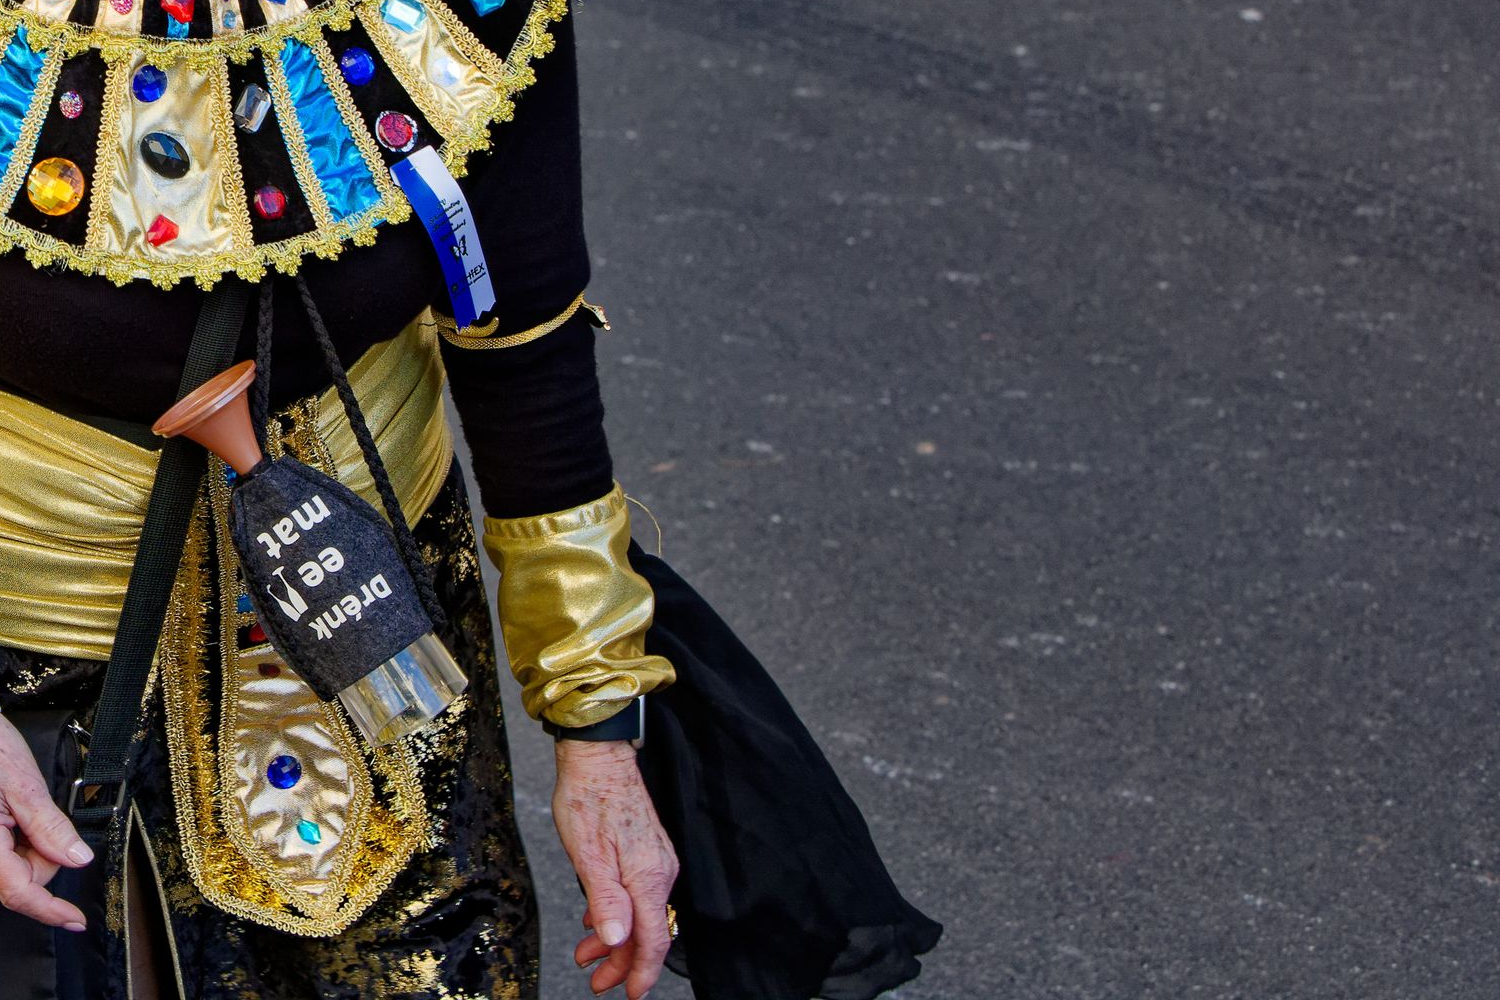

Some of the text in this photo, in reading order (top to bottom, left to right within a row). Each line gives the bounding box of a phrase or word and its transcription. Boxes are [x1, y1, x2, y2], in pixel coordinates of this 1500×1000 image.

[256, 494, 332, 560] mat
[297, 546, 345, 588] ee
[308, 573, 393, 641] Drénk
